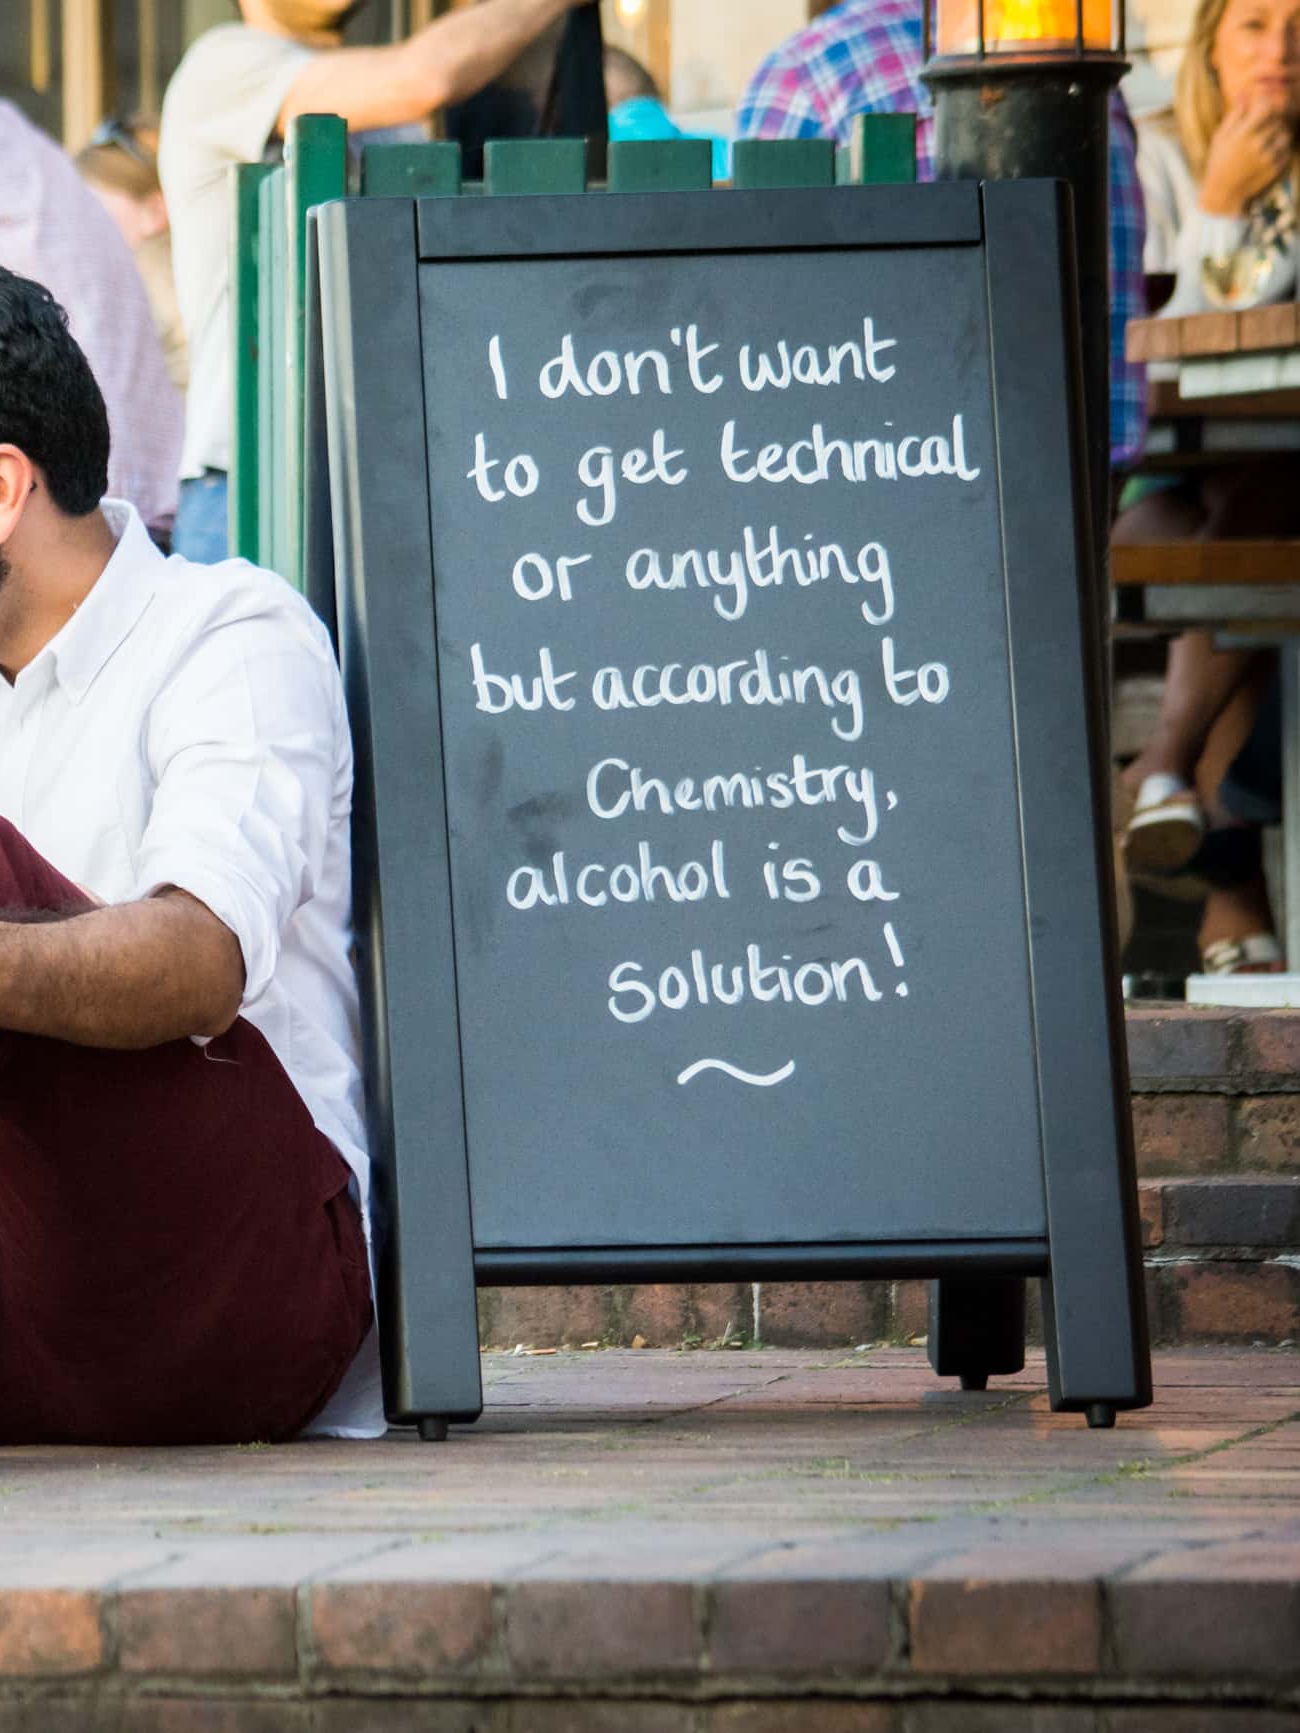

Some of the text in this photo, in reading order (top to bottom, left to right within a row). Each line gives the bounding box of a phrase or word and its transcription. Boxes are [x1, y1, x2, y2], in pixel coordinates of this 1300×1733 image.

[488, 317, 897, 400] I don't want
[466, 413, 981, 527] to get technical
[511, 525, 895, 626] or anything
[469, 636, 950, 742] but according to
[586, 753, 899, 847] Chemistry,
[506, 839, 901, 911] alcohol is a
